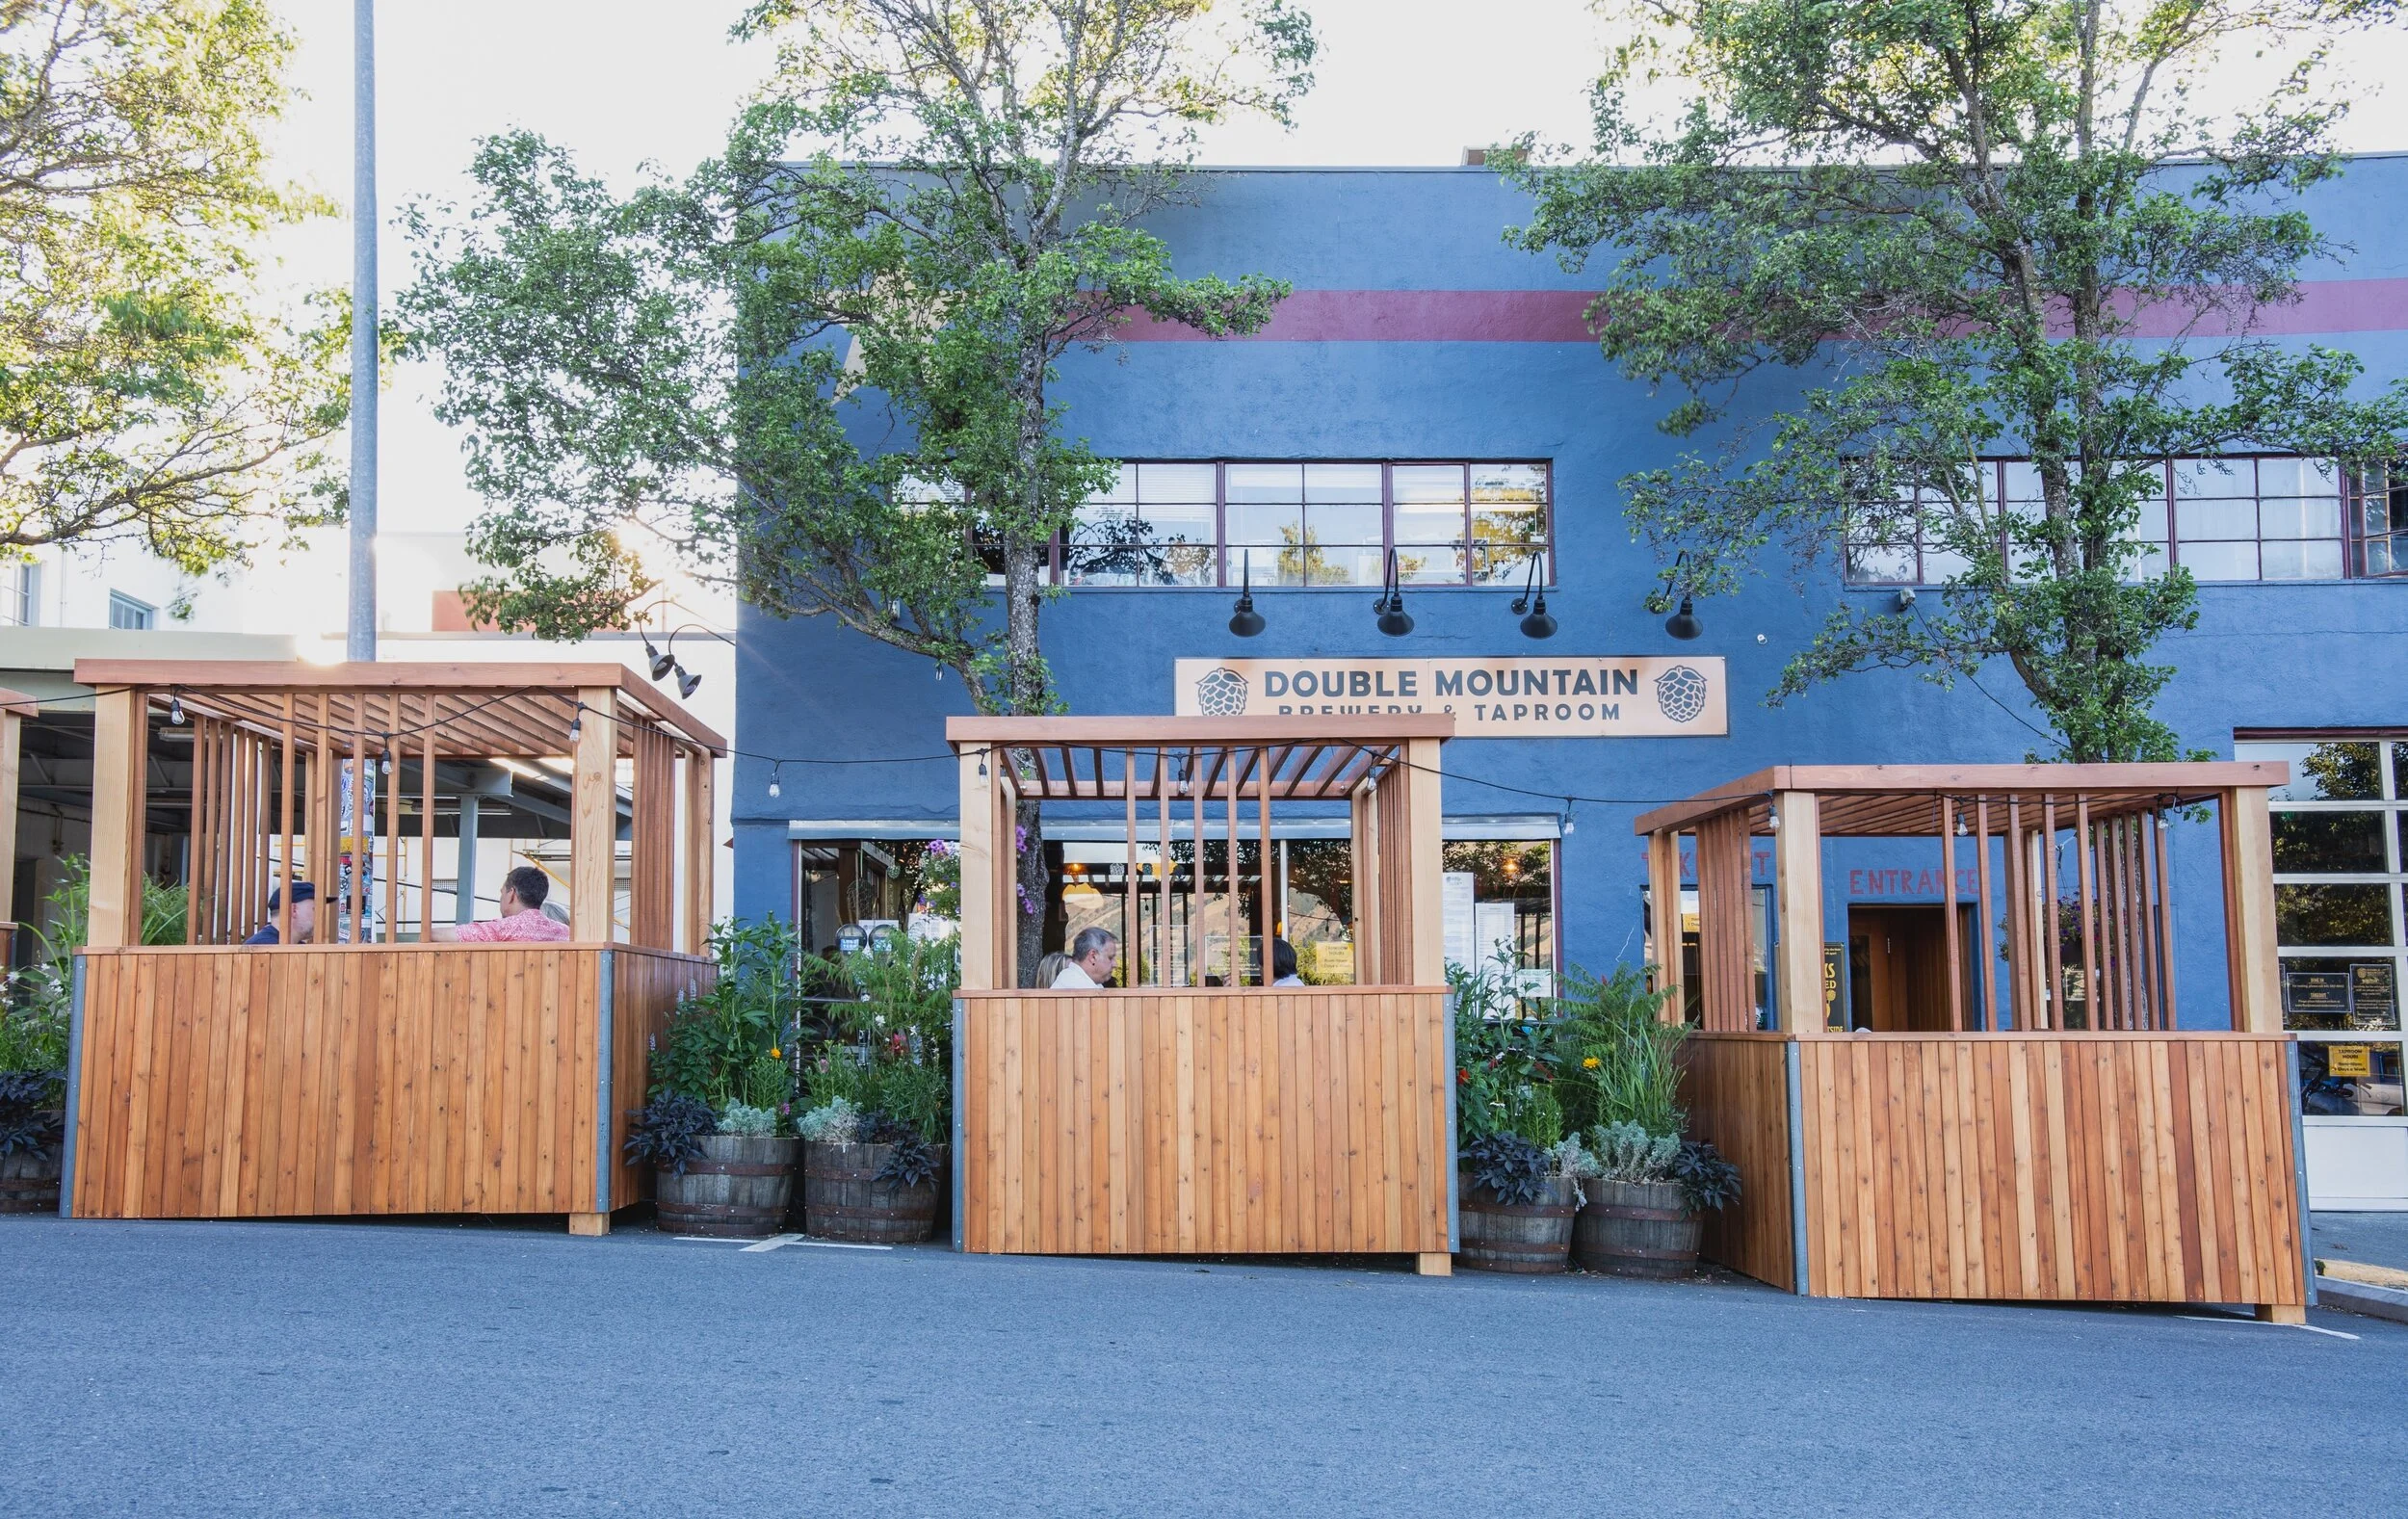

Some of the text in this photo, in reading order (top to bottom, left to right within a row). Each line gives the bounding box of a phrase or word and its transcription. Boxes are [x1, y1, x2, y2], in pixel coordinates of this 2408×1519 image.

[1265, 668, 1637, 698] DOUBLE MOUNTAIN
[1474, 703, 1620, 720] TAPROOM
[1849, 869, 1979, 895] ENTRANCE
